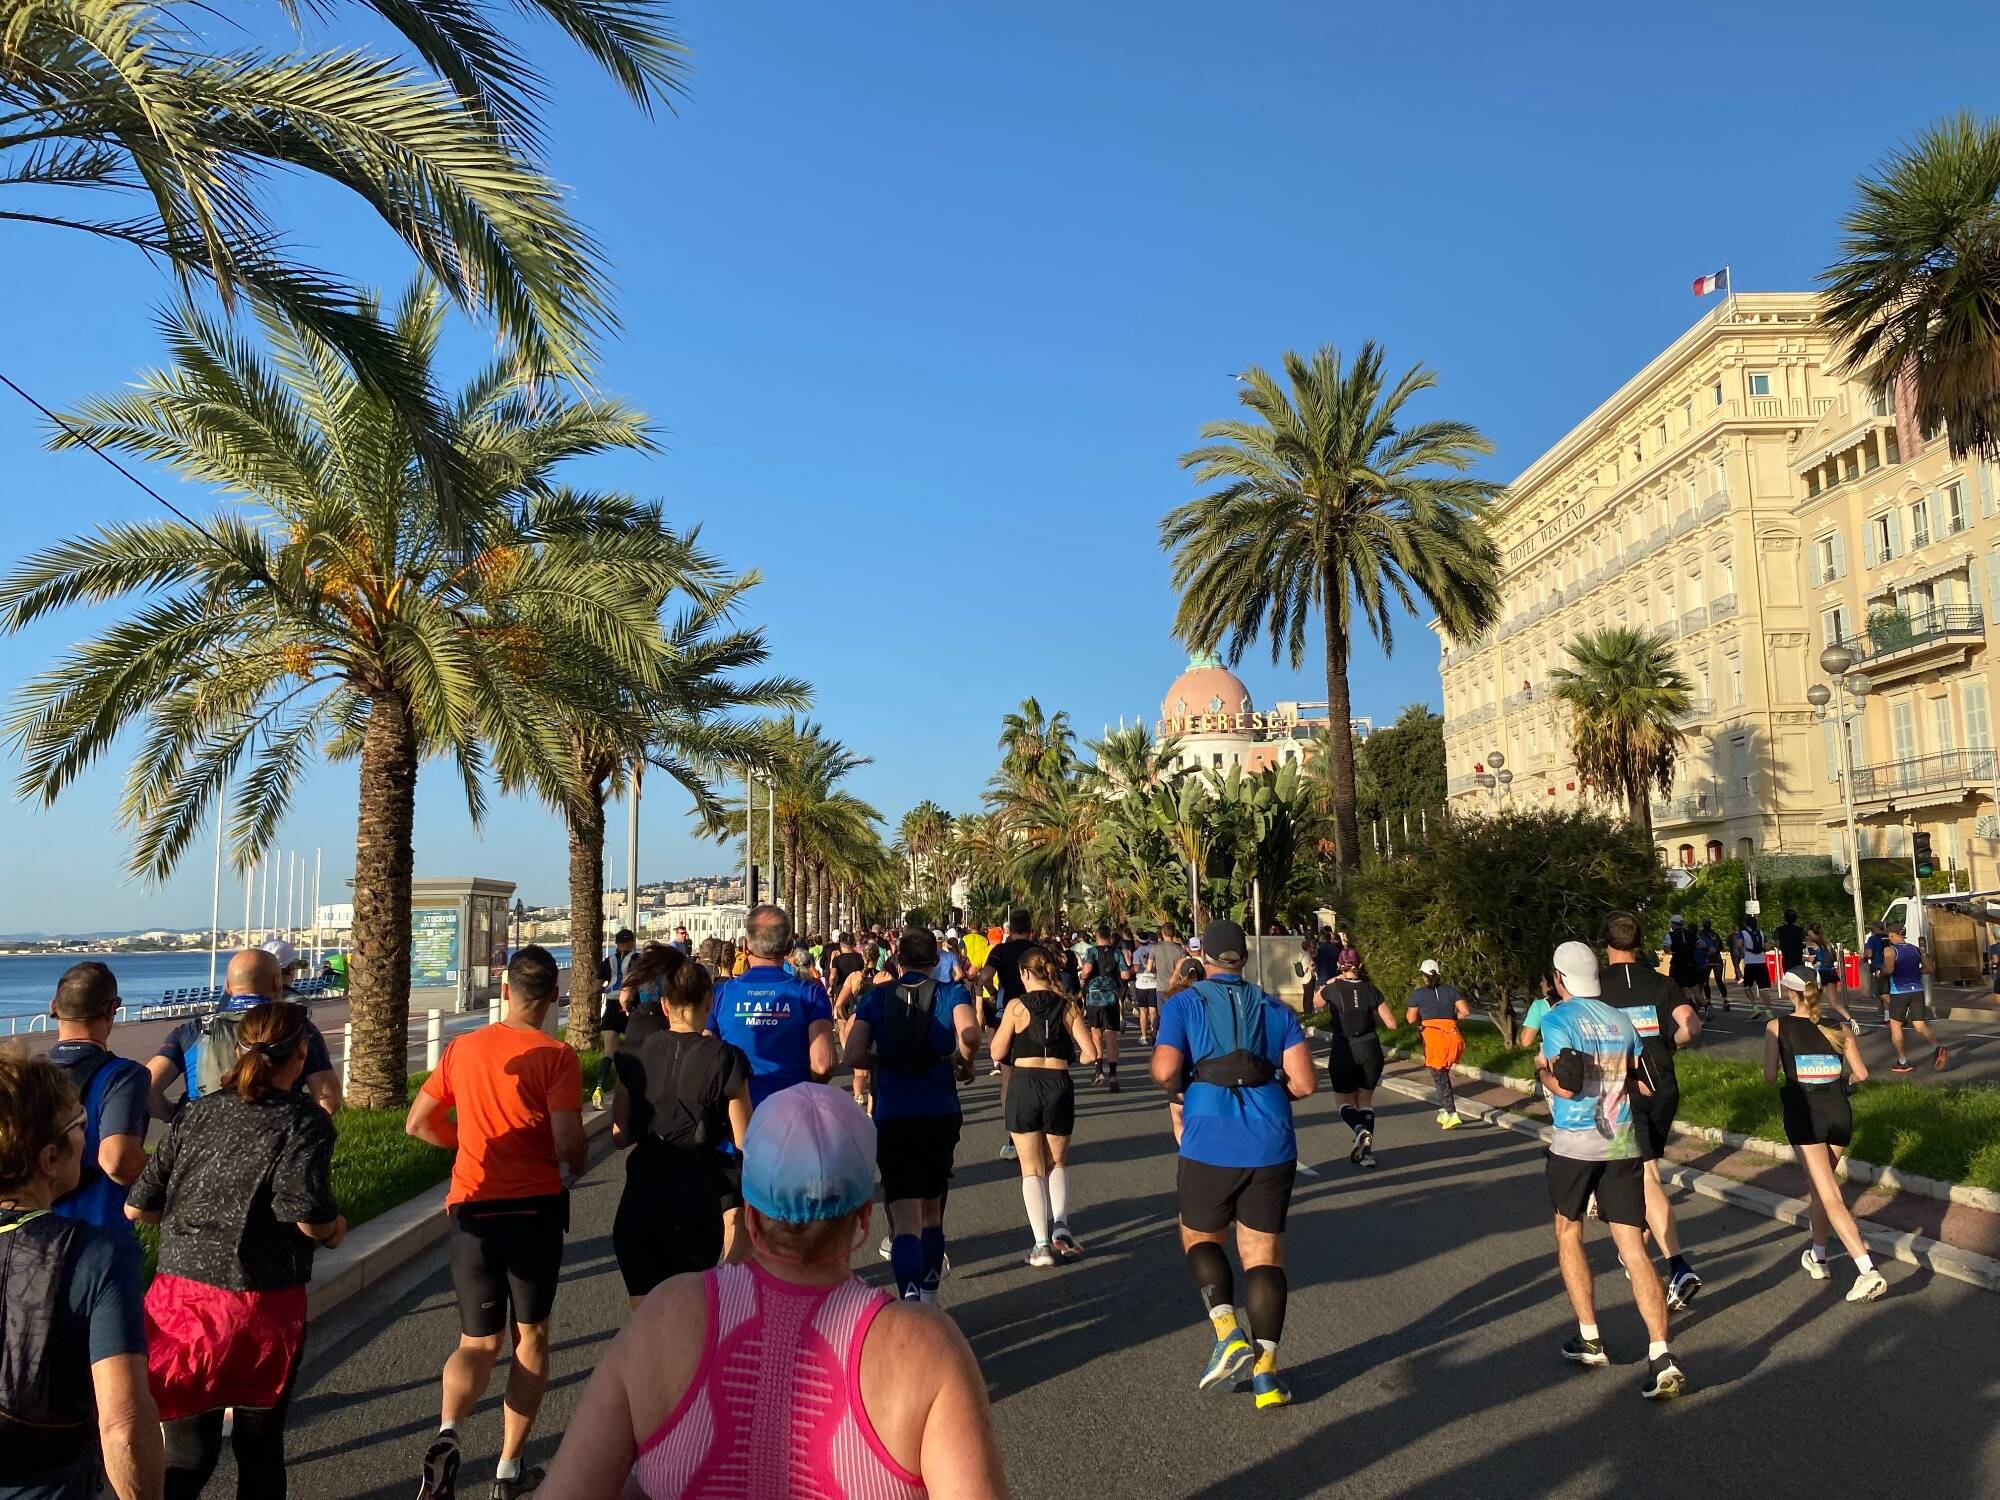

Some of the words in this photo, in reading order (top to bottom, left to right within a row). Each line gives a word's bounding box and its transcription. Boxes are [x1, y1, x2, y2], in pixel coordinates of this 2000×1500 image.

[1510, 538, 1536, 566] HOTEL
[1171, 710, 1297, 733] NEGRESCO
[736, 1002, 790, 1012] ITALIA
[745, 1017, 778, 1026] Marco
